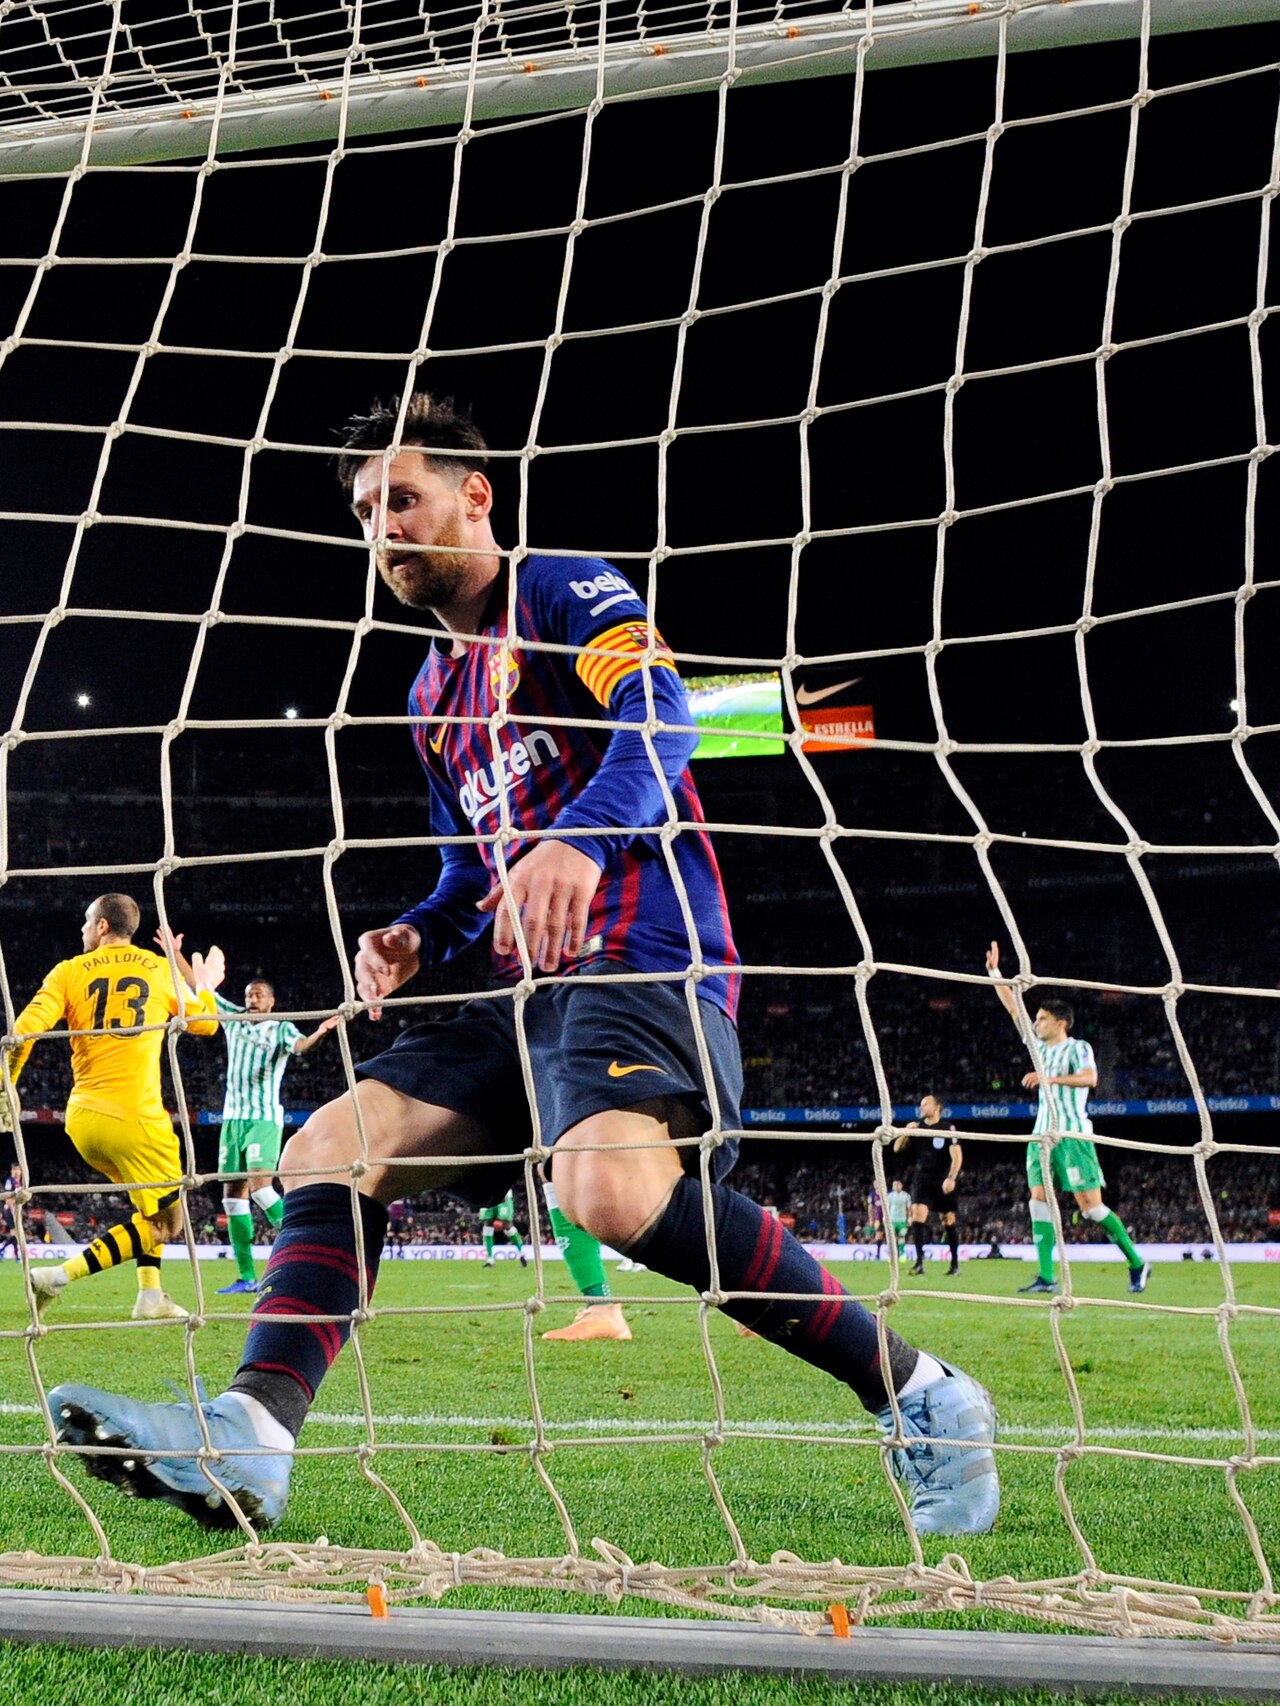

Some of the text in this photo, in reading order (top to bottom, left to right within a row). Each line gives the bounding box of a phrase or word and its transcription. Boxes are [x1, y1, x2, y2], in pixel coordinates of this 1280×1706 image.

[815, 721, 874, 736] ESTRELLA
[459, 730, 560, 818] akuten
[83, 953, 158, 973] PAU LOPEZ
[86, 976, 149, 1038] 13
[972, 1105, 1009, 1117] beko
[1087, 1102, 1127, 1114] beko
[1147, 1100, 1188, 1113] beko
[1208, 1098, 1248, 1111] beko
[751, 1110, 786, 1121] beko
[805, 1108, 841, 1120] beko
[411, 1250, 455, 1260] YOUR
